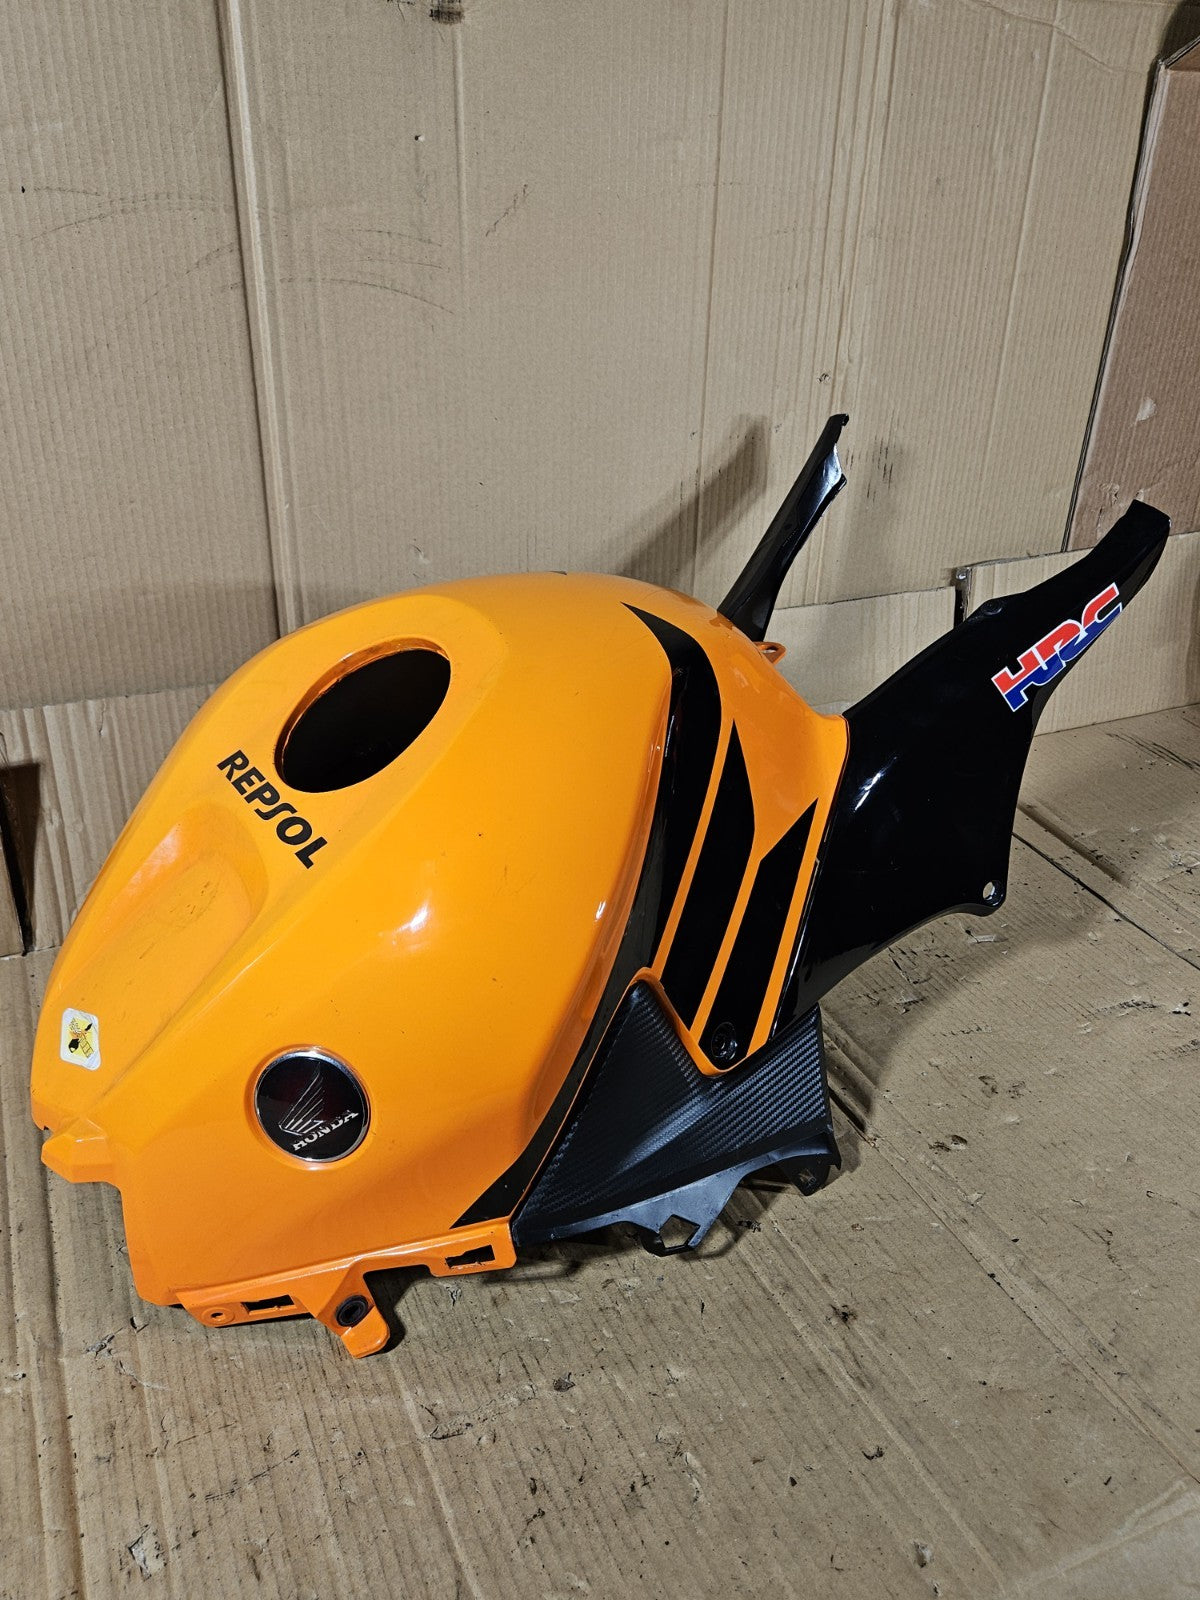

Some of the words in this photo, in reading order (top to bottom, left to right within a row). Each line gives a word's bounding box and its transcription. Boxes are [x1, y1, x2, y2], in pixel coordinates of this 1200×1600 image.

[991, 582, 1122, 712] HRC
[217, 749, 328, 869] REPSOL
[292, 1109, 359, 1151] HONDA
